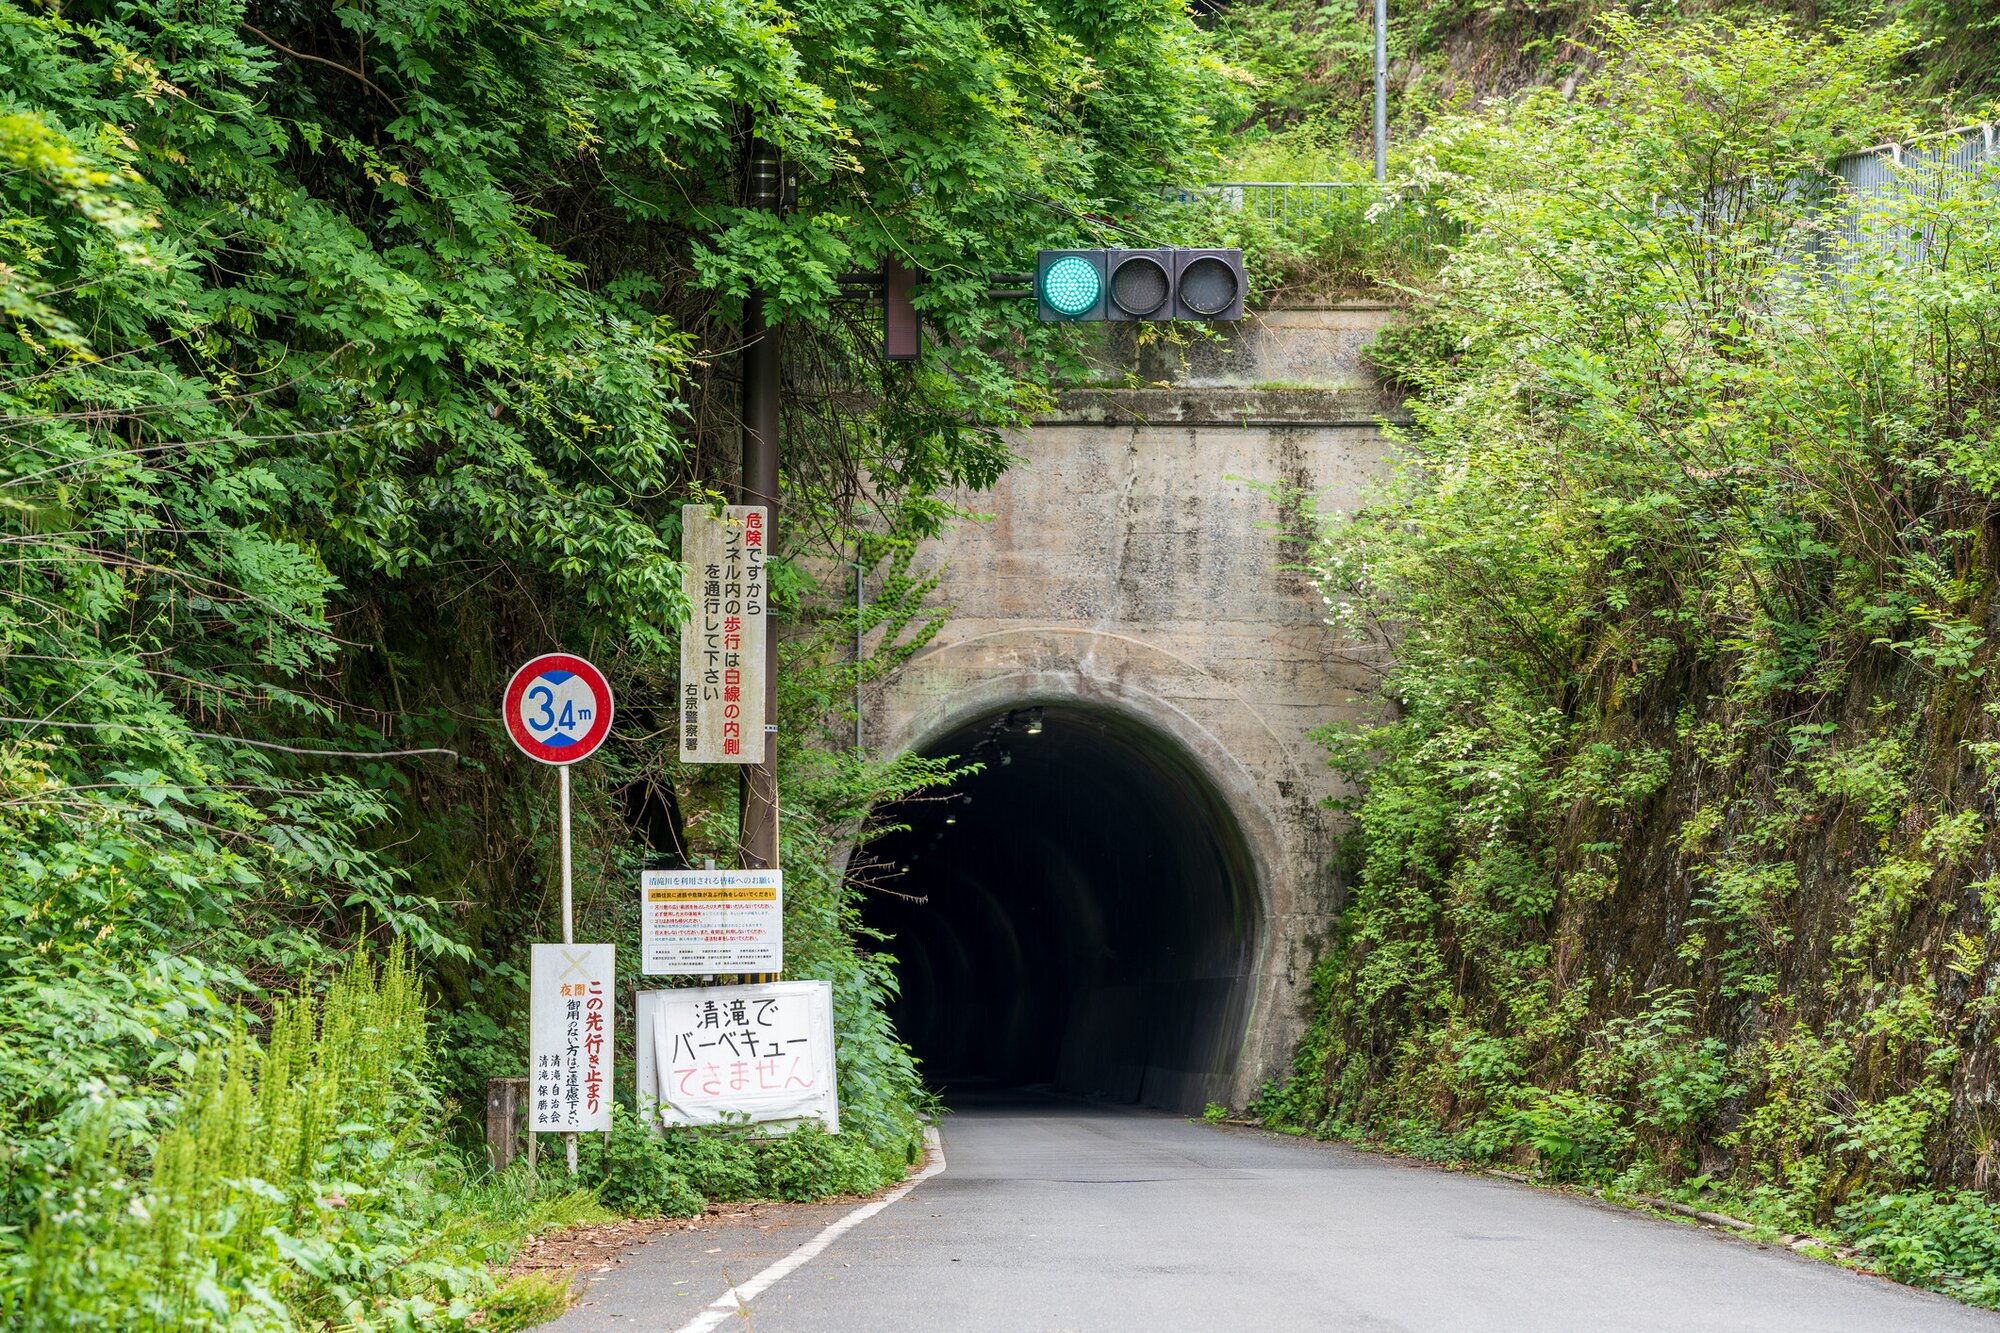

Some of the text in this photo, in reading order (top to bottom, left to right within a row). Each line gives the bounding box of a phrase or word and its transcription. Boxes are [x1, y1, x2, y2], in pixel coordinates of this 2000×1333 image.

[745, 512, 763, 616] 危険ですから
[704, 563, 721, 701] を通行して下さい
[684, 683, 698, 751] 右京警察署
[649, 876, 775, 886] 清滝川を利用される皆様へのお願い
[560, 983, 586, 997] 夜間
[694, 999, 778, 1029] 清滝で
[584, 981, 604, 1115] この先行き止まり
[672, 1029, 808, 1063] バーベキュー
[538, 1054, 549, 1124] 清滝保勝会
[550, 1054, 561, 1123] 清滝自治会
